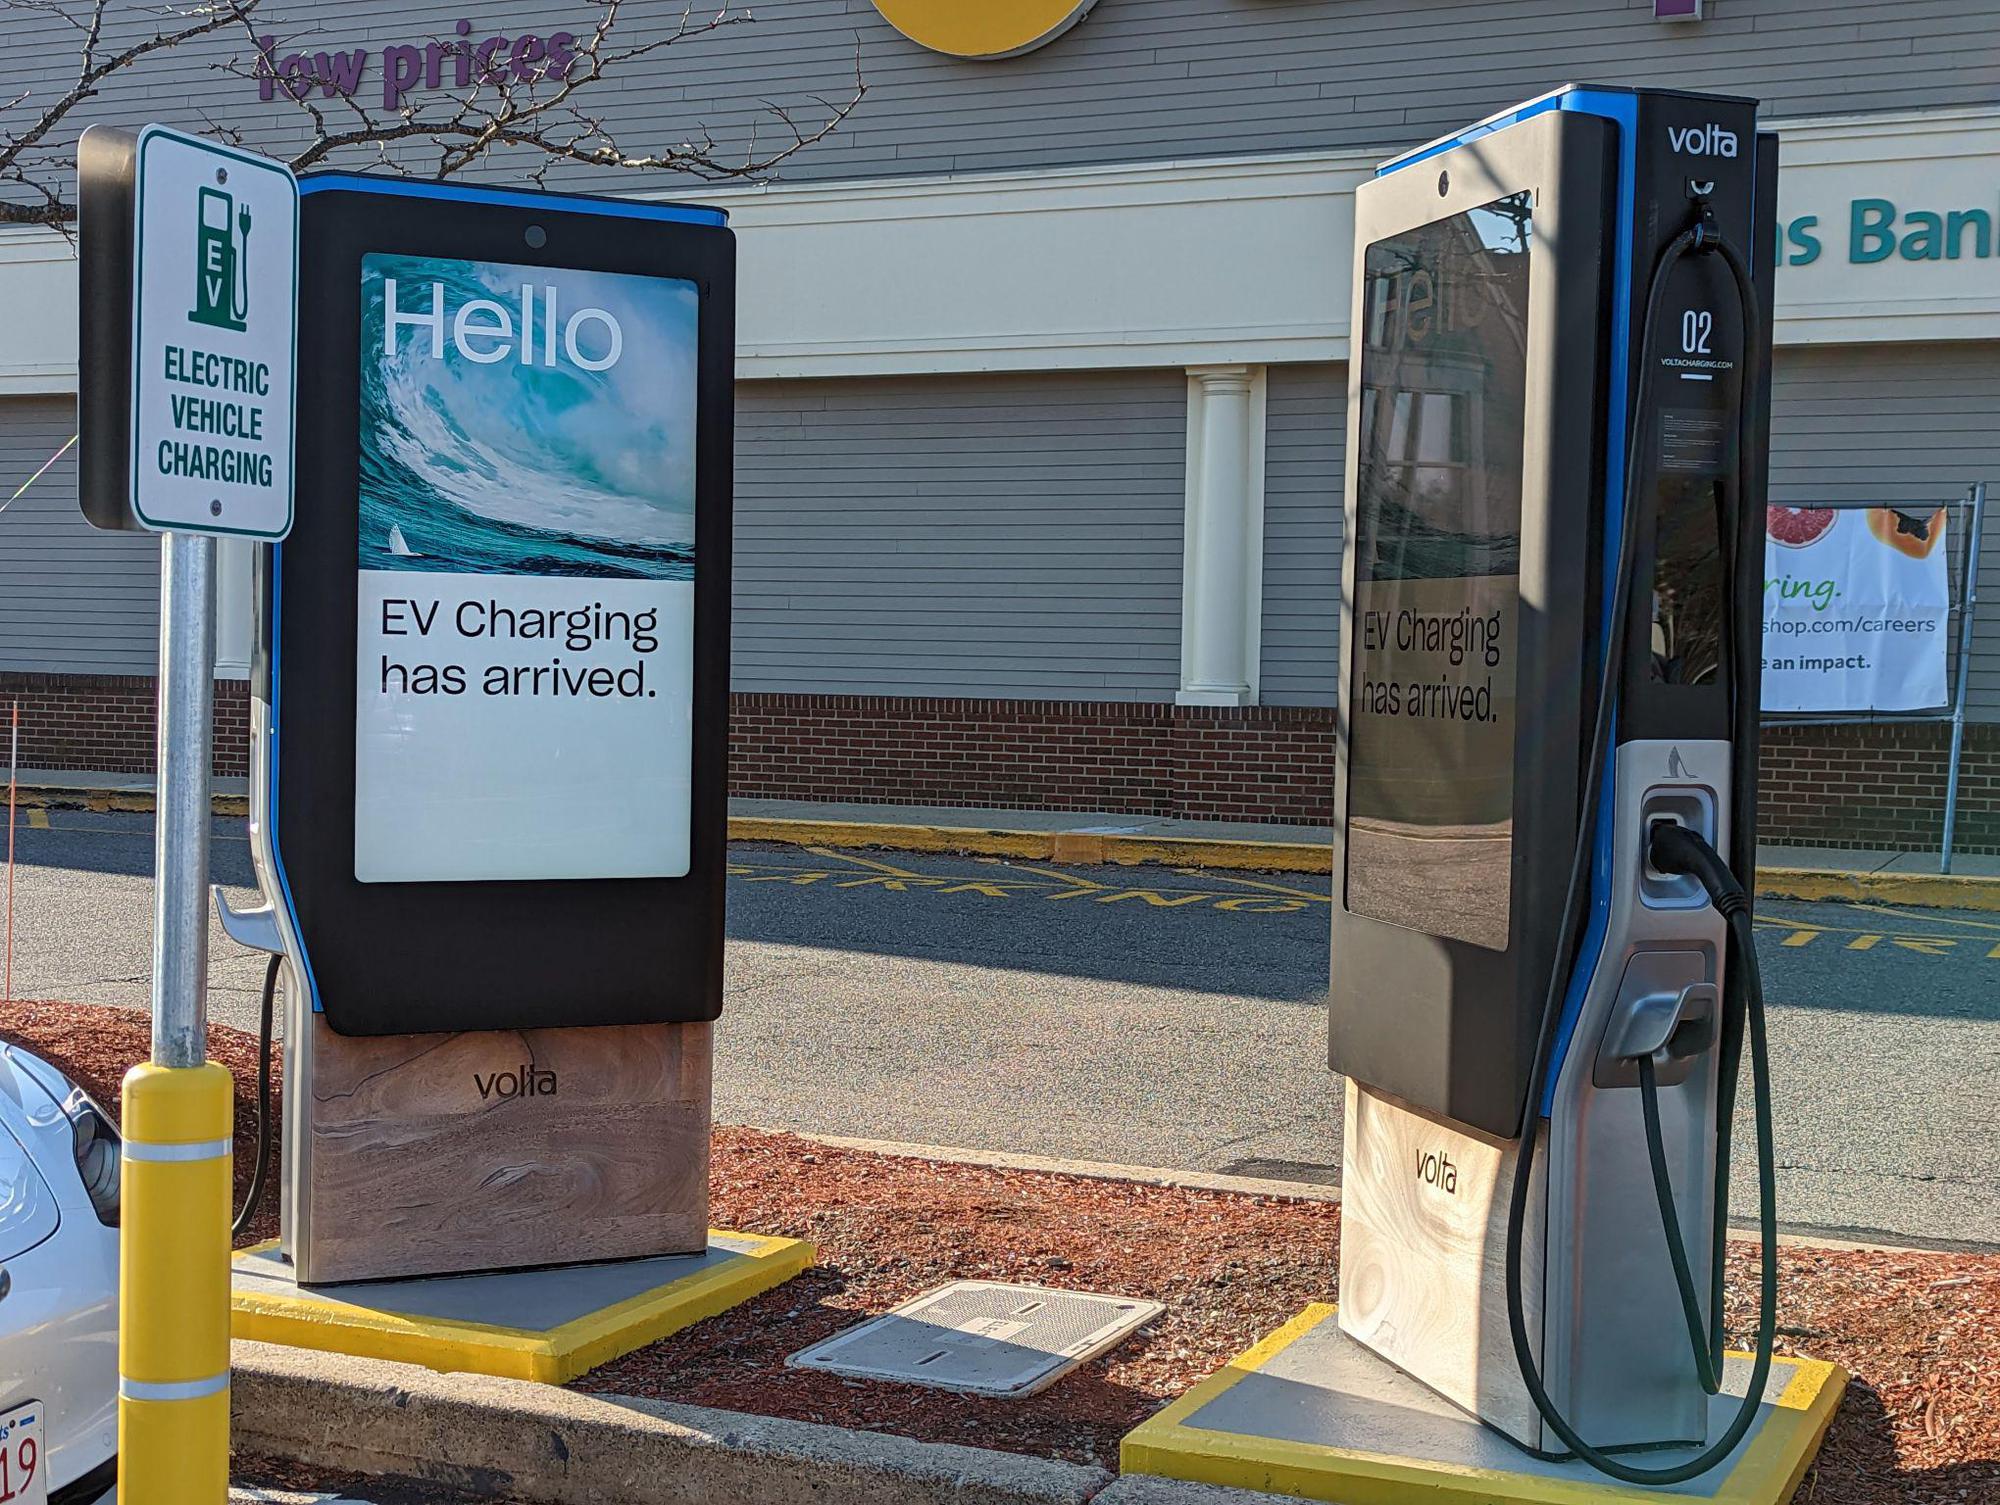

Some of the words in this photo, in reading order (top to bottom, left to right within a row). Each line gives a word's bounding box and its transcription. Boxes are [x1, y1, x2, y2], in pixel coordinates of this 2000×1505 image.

[259, 35, 366, 100] low
[382, 19, 576, 111] prices
[1667, 123, 1738, 158] volta
[1775, 216, 1822, 267] s
[1849, 198, 2000, 264] Ban
[207, 238, 222, 308] EV
[384, 278, 623, 371] Hello
[1682, 310, 1712, 354] 02
[164, 345, 270, 396] ELECTRIC
[1661, 358, 1733, 369] VOLTACHARGING.COM
[170, 394, 263, 441] VEHICLE
[158, 439, 273, 488] CHARGING
[381, 599, 440, 636] EV
[455, 600, 658, 653] Charging
[1364, 611, 1391, 650] EV
[1397, 606, 1501, 667] Charging
[381, 655, 466, 695] has
[482, 658, 656, 697] arrived.
[1772, 658, 1795, 670] an
[1799, 654, 1871, 673] impact.
[1361, 671, 1400, 716] has
[1407, 674, 1497, 723] arrived.
[727, 868, 1310, 913] ARKING
[473, 1064, 557, 1099] volta
[1416, 1148, 1457, 1194] volta
